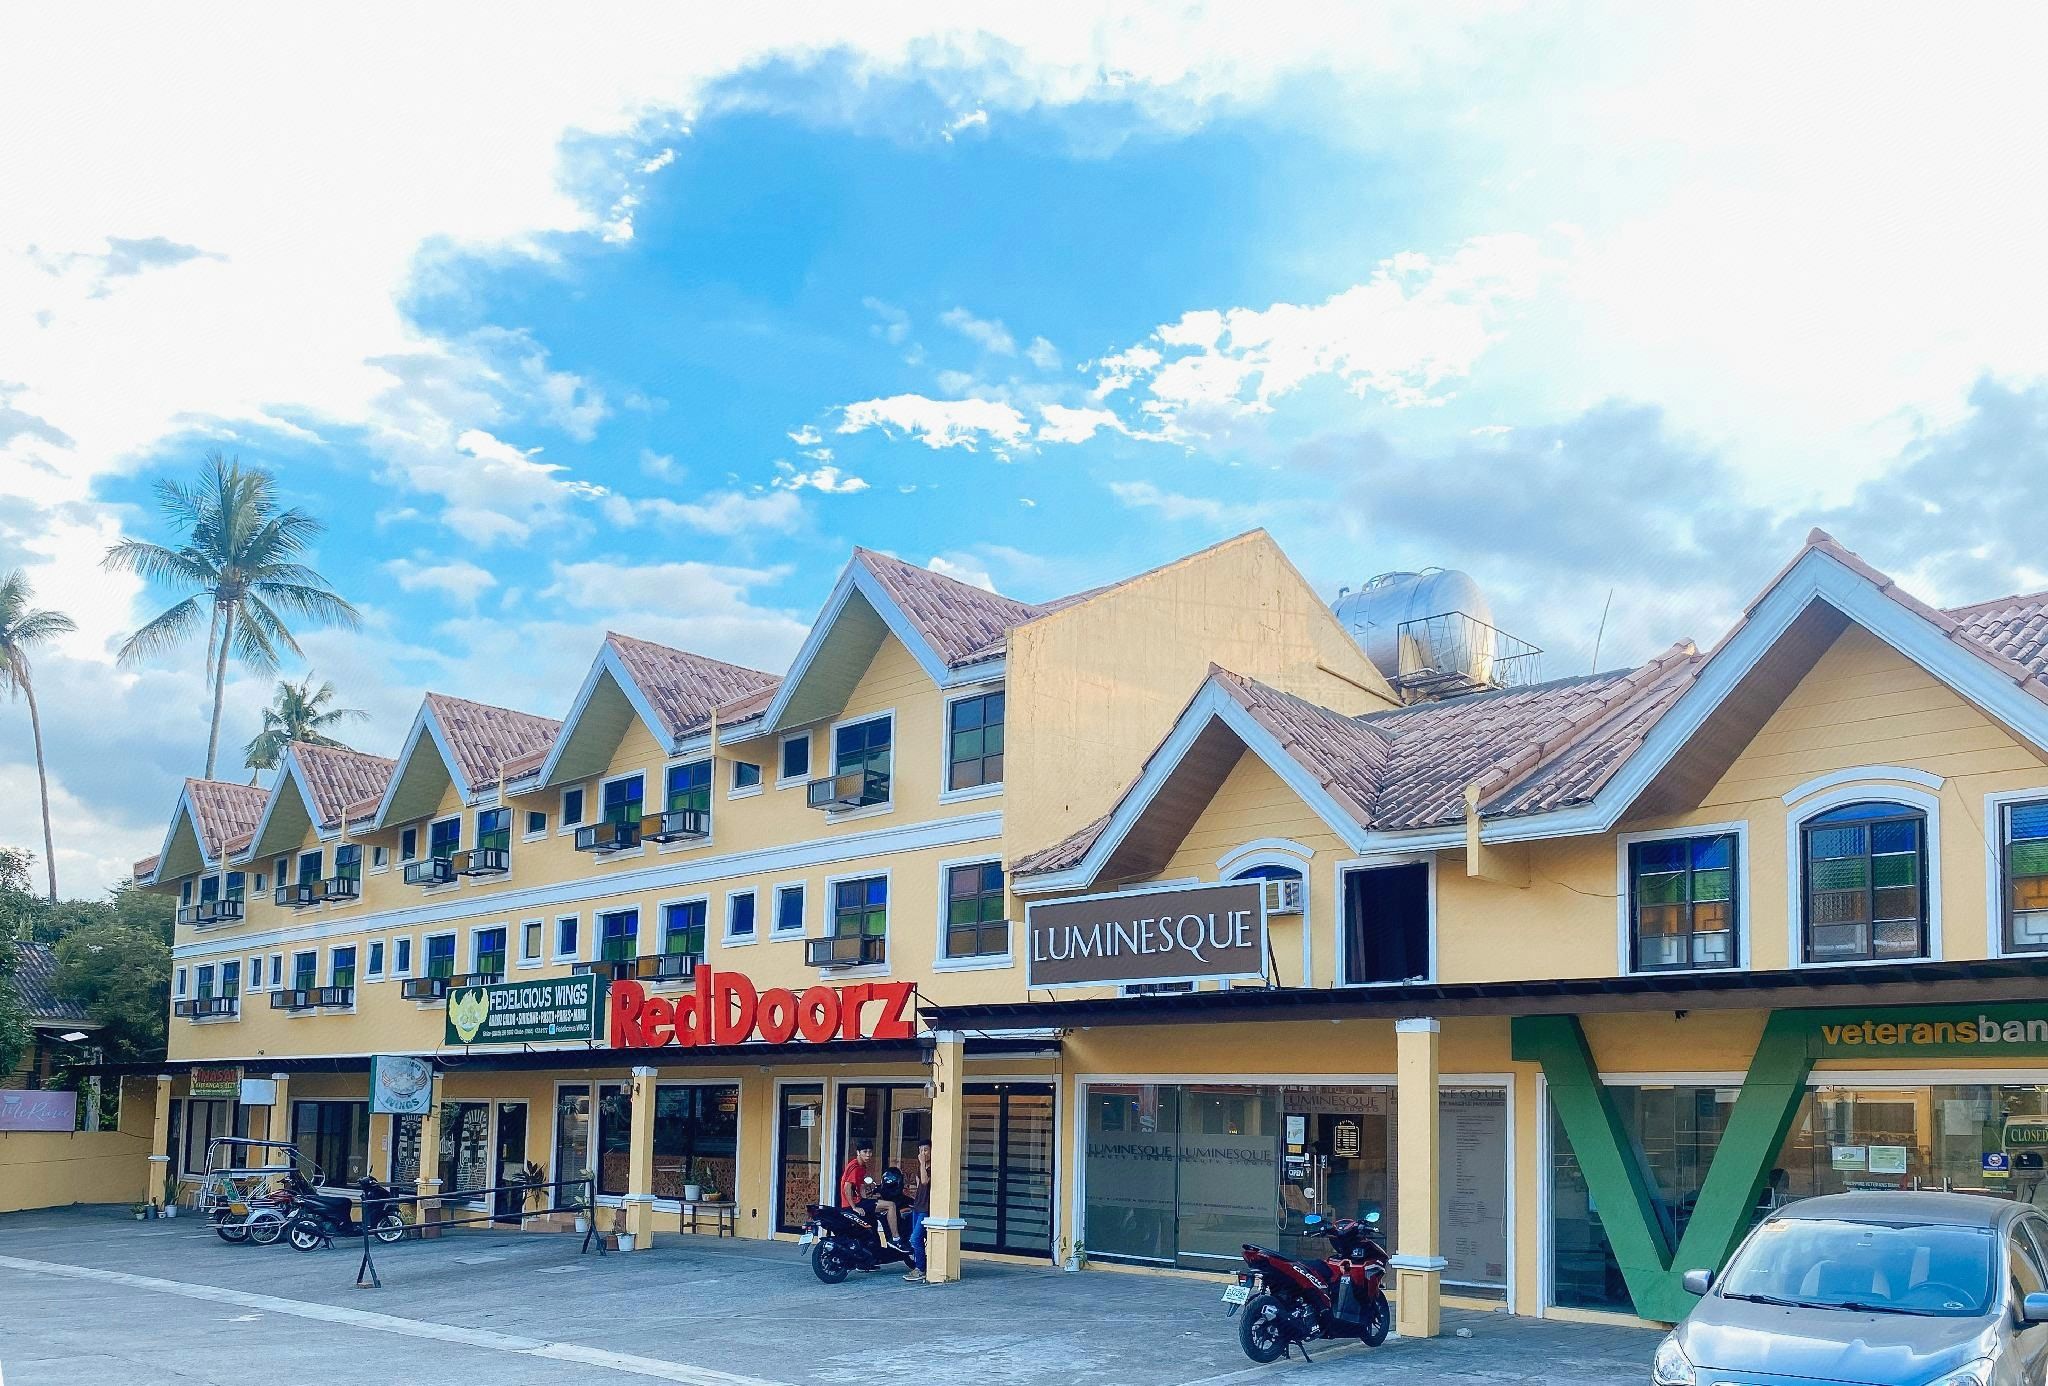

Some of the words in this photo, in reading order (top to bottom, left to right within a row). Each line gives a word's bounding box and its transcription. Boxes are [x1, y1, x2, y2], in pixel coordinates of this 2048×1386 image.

[1034, 911, 1252, 963] LUMINESQUE
[489, 987, 551, 1011] FEDELICIOUS
[555, 983, 588, 1006] WINGS
[610, 964, 916, 1049] RedDoorz
[385, 1096, 420, 1110] WINGS
[1283, 1095, 1380, 1107] LUMINESQUE
[1088, 1143, 1173, 1157] LUMINESQUE
[1179, 1146, 1272, 1161] LUMINESQUE
[1288, 1169, 1304, 1177] OPEN
